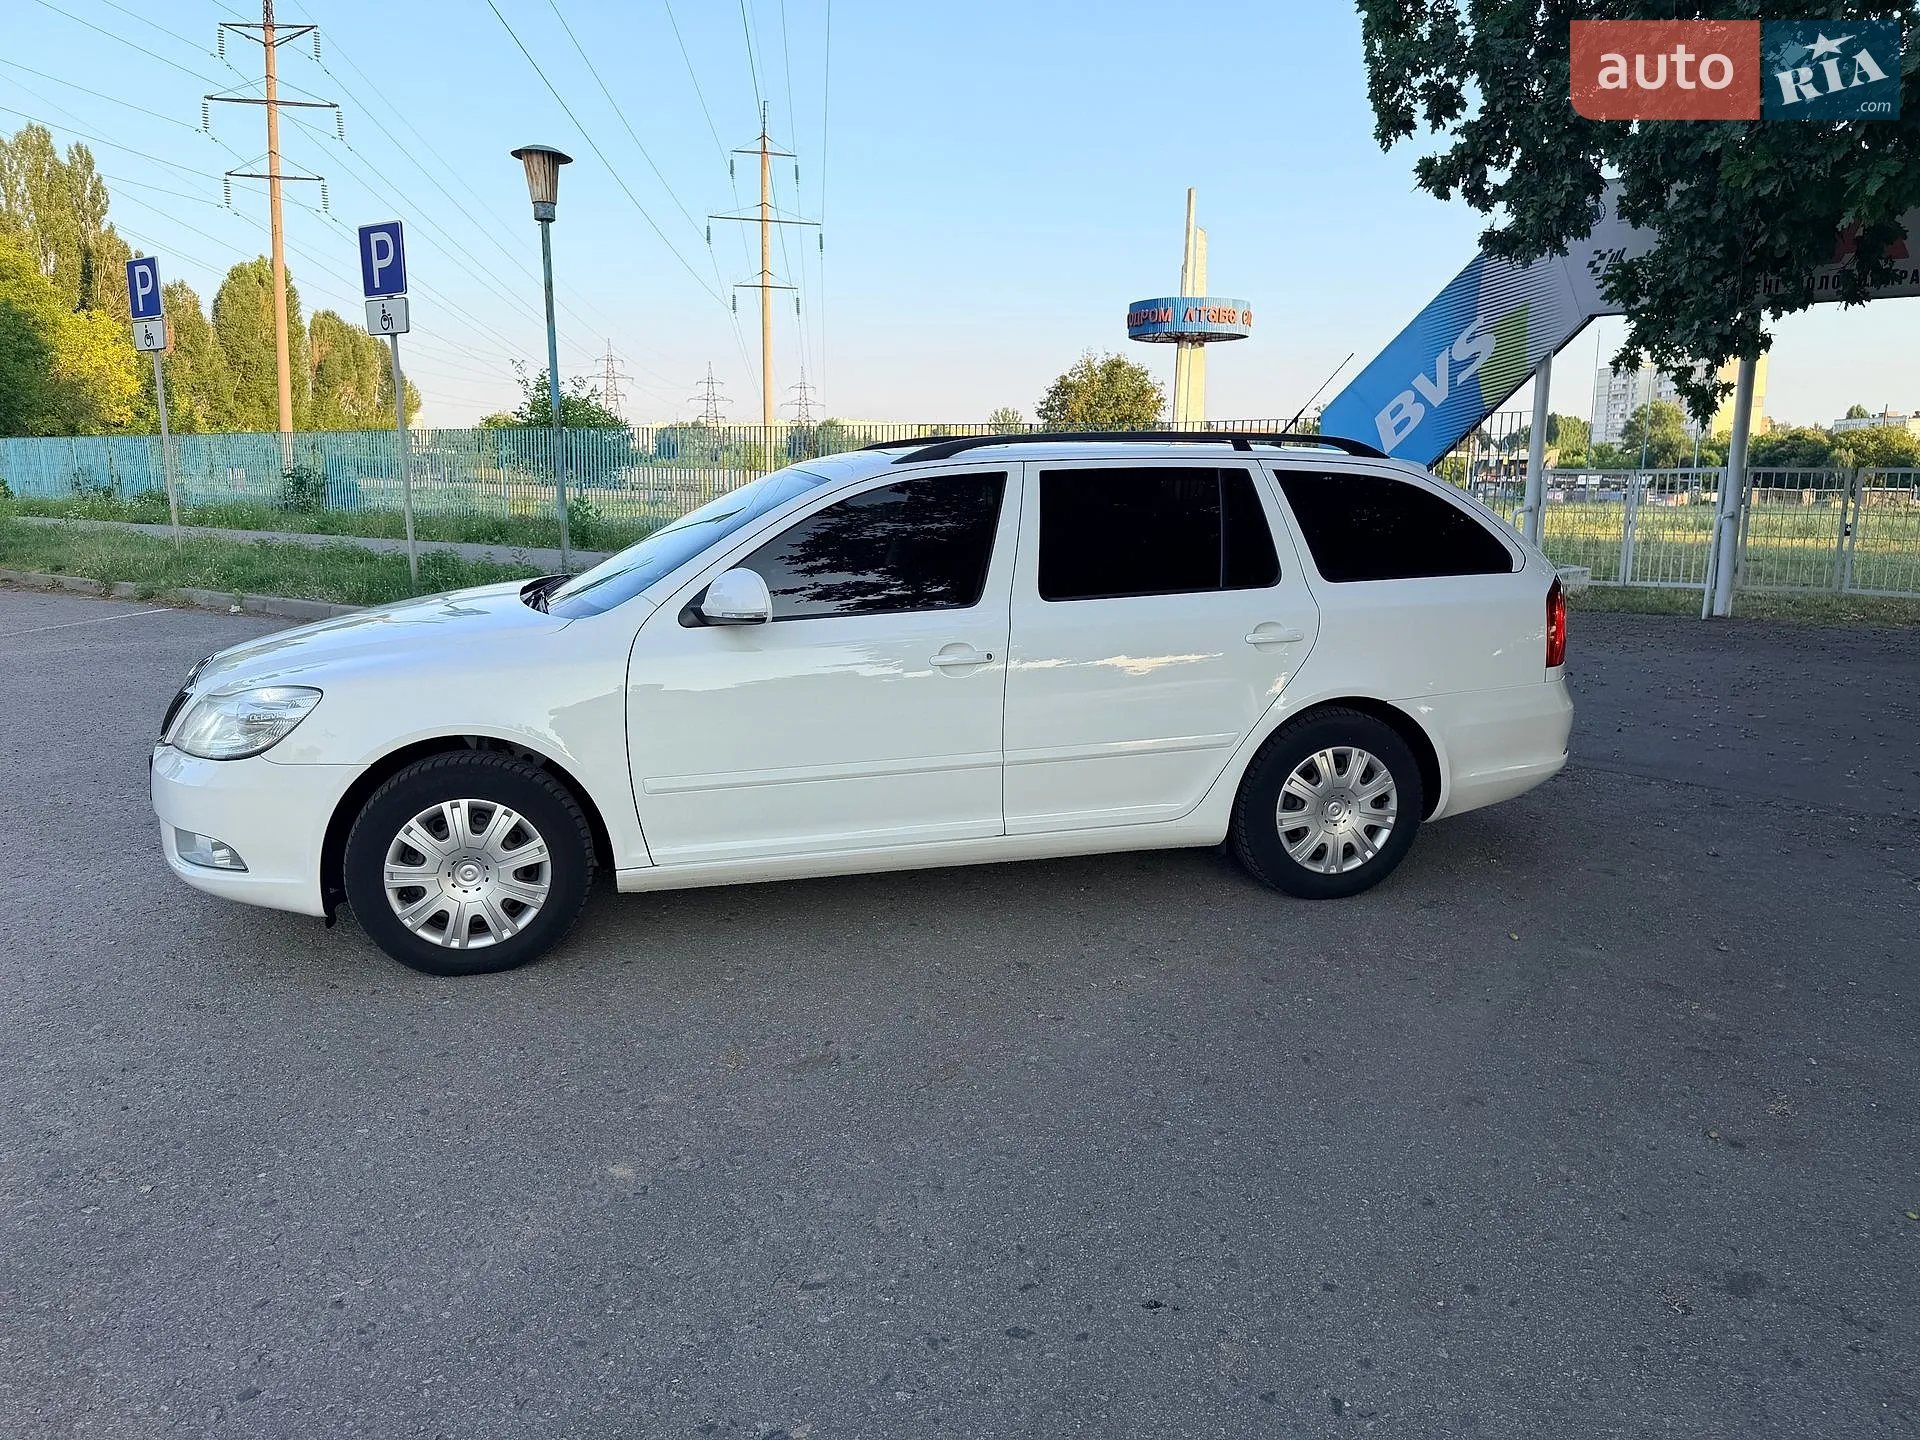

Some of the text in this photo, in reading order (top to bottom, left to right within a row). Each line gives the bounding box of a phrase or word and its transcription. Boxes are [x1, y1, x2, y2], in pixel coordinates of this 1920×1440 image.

[134, 264, 153, 312] P
[370, 231, 394, 289] P
[1374, 315, 1497, 455] BVS
